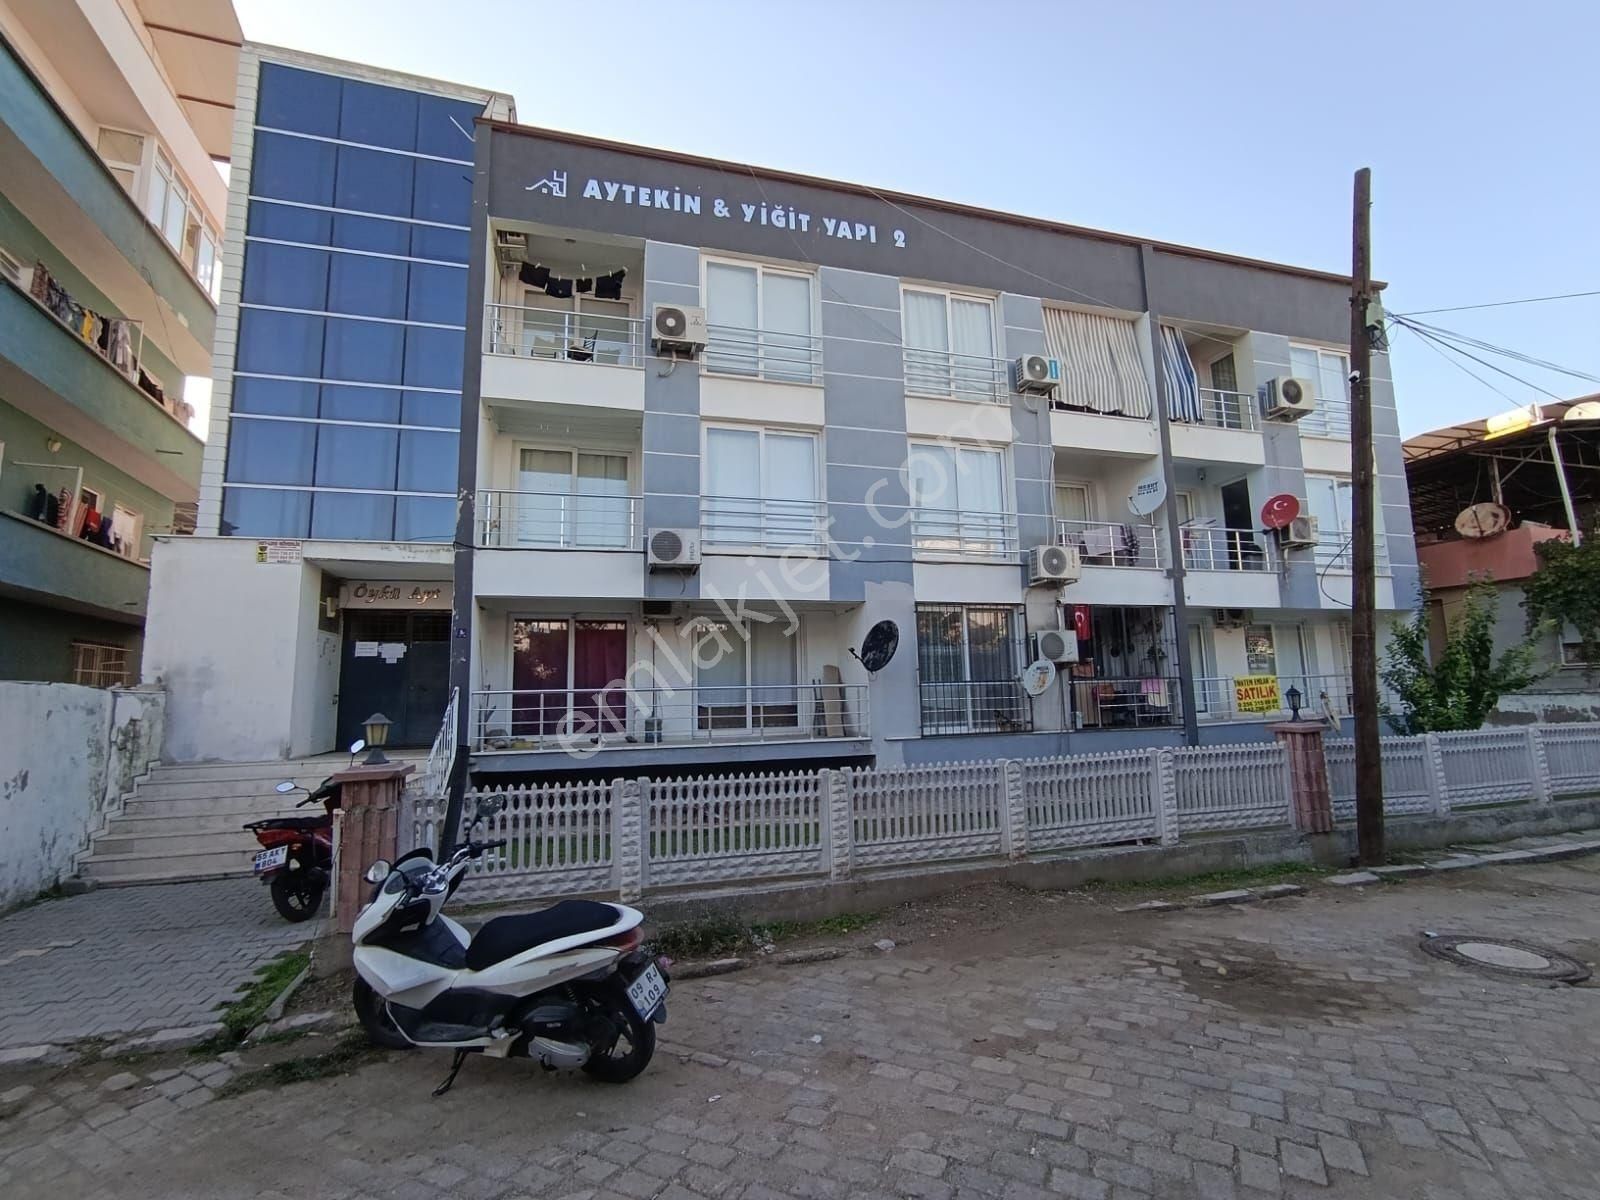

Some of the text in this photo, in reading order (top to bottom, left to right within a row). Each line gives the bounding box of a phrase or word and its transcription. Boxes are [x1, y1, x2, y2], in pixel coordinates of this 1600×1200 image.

[582, 178, 906, 248] AYTEKİN & YİĞİT YAPI 2
[1236, 685, 1277, 701] SATILIK
[631, 966, 658, 999] 09 RJ
[643, 984, 661, 1006] 109
